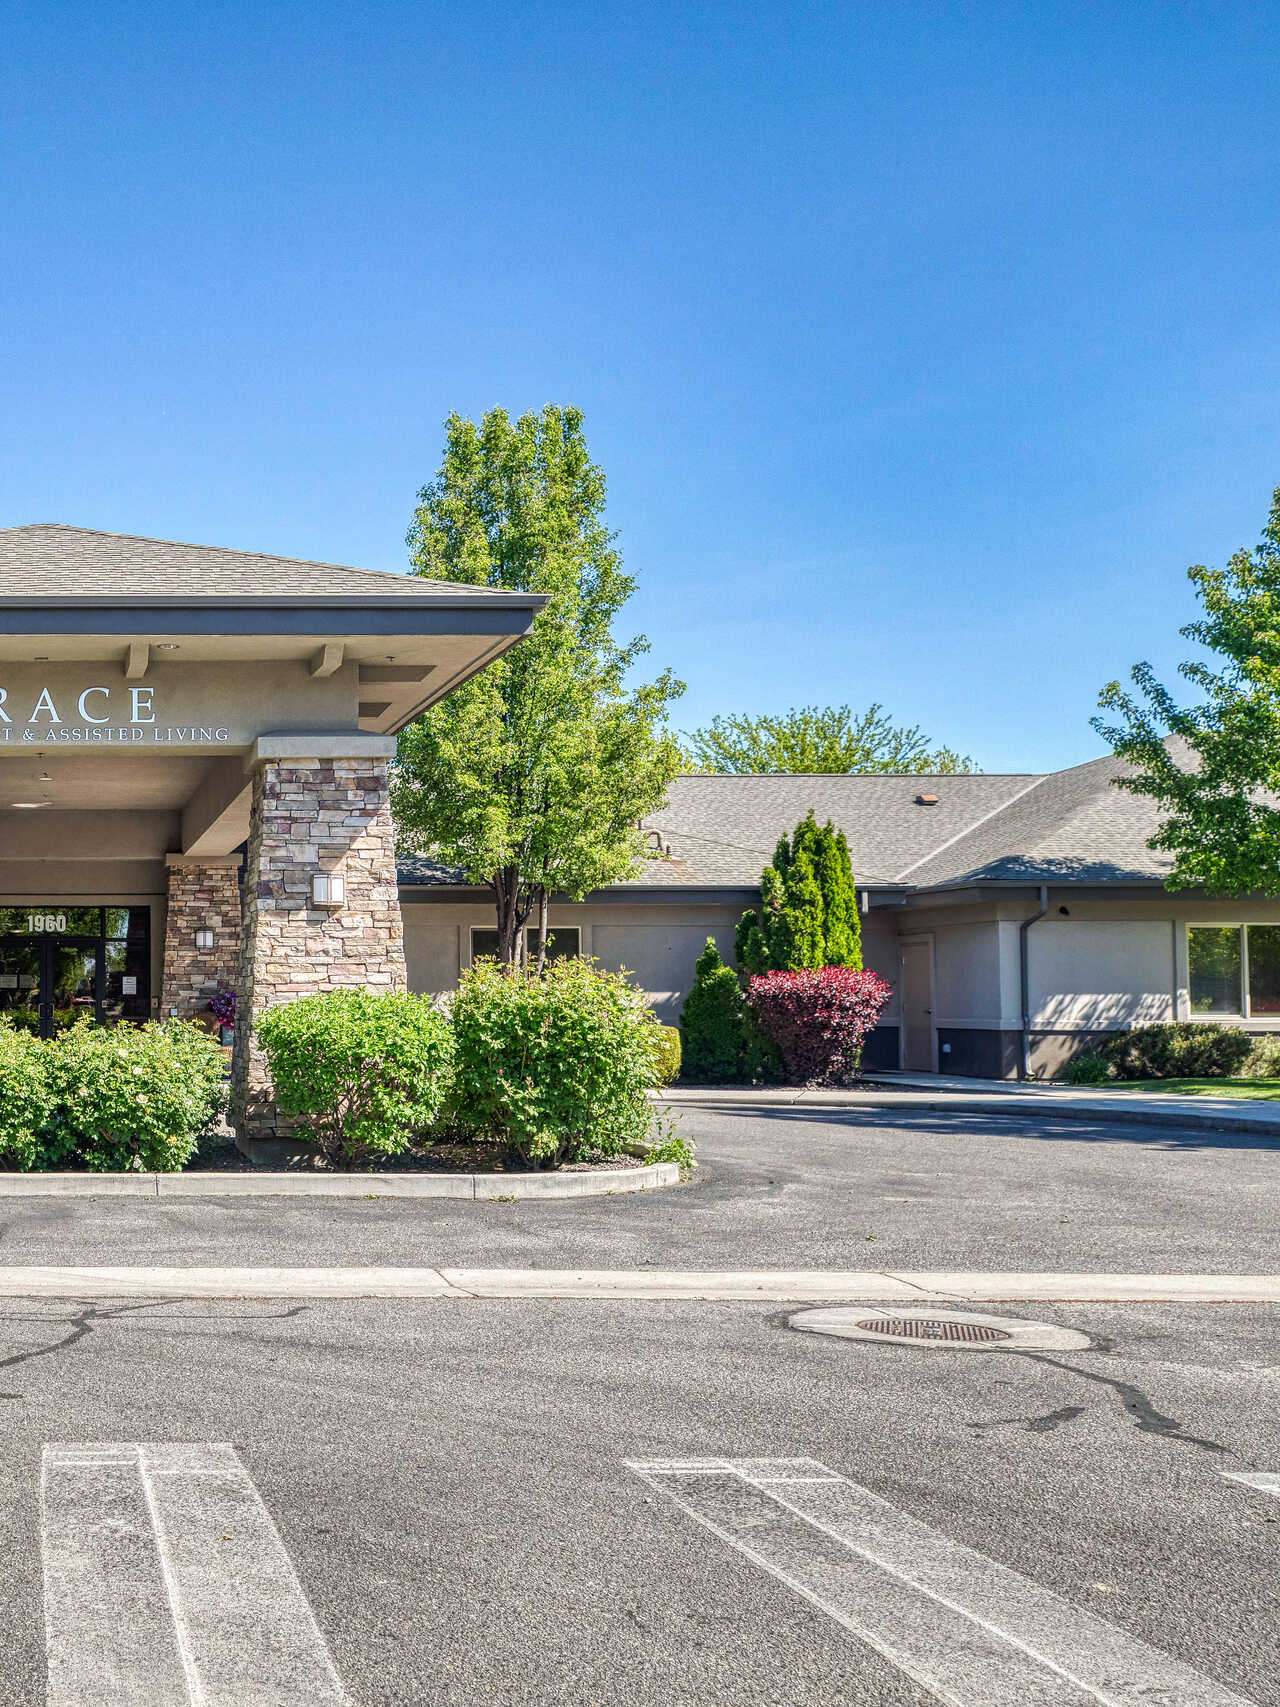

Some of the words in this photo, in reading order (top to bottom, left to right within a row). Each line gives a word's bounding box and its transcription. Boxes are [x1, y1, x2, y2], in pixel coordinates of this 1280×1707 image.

[23, 727, 35, 741] &
[46, 727, 144, 741] ASSISTED
[154, 727, 230, 741] LIVING
[27, 914, 67, 932] 1960
